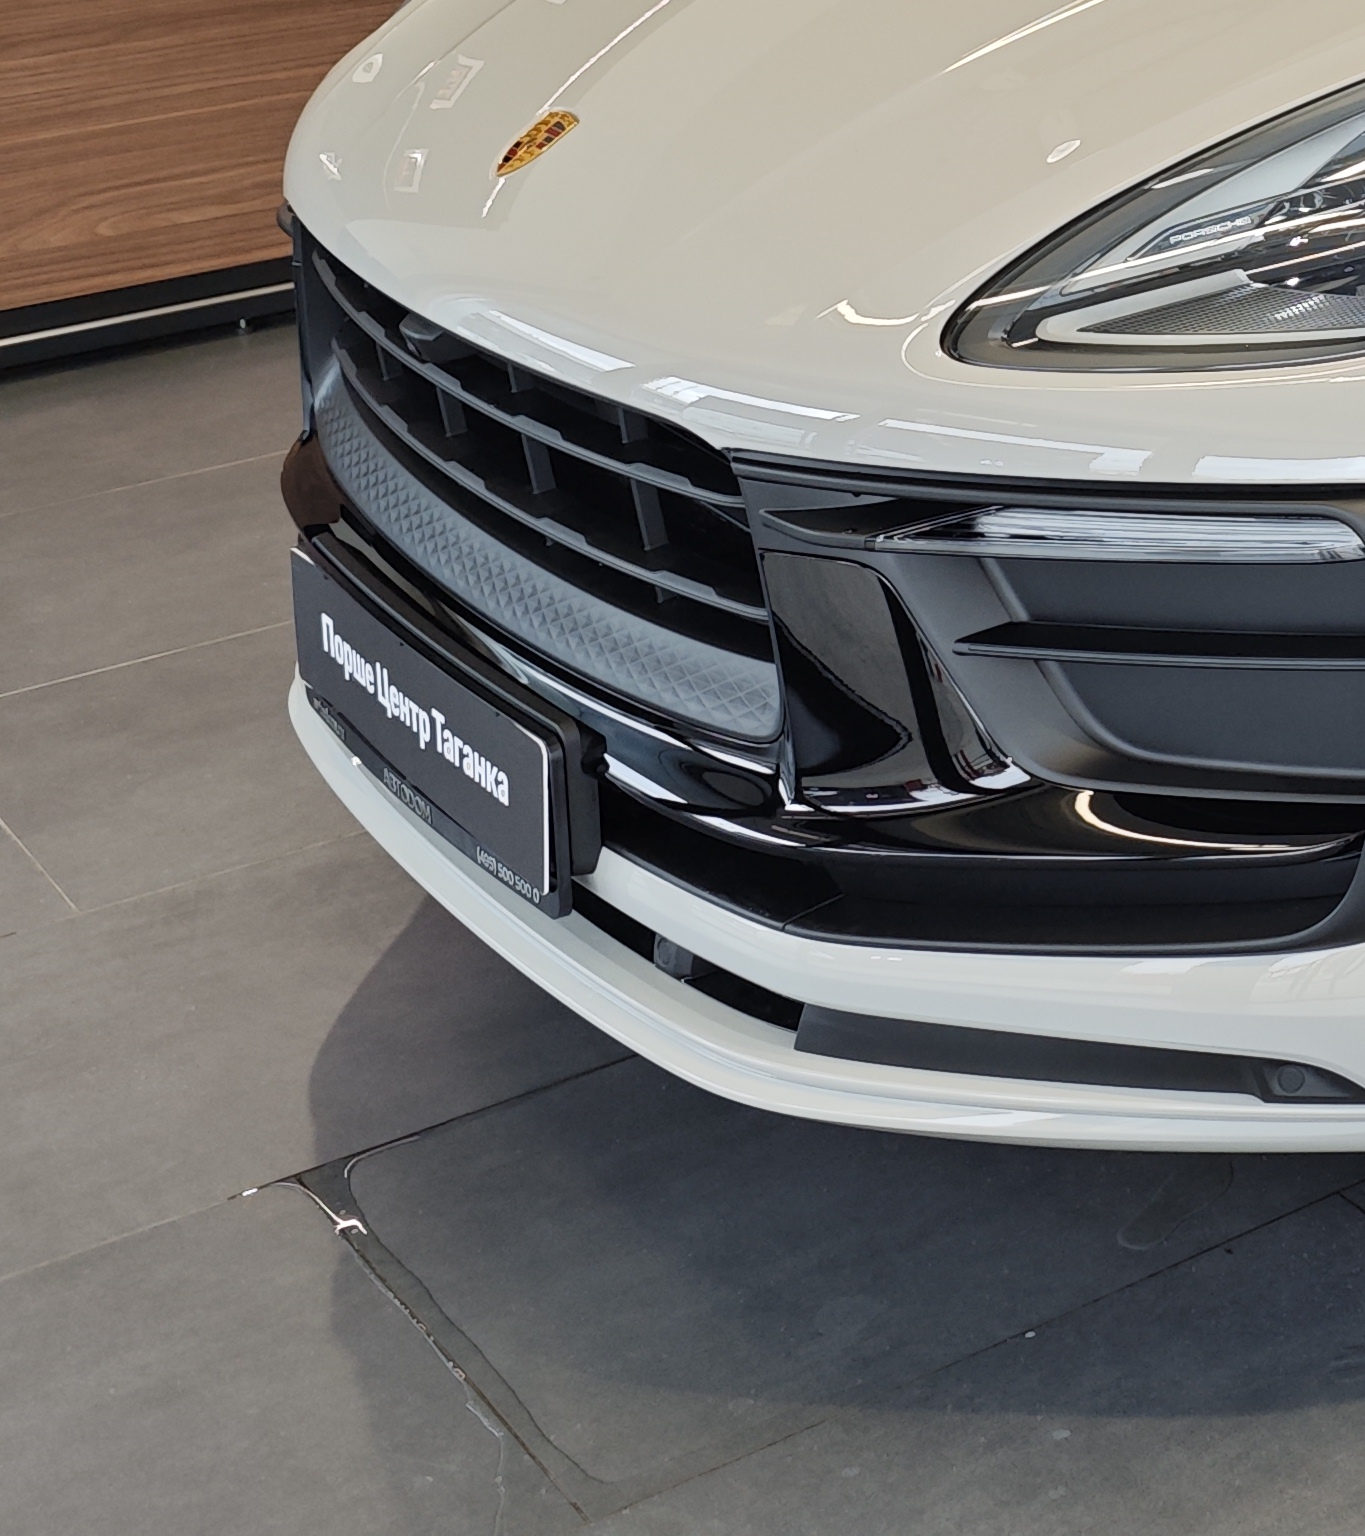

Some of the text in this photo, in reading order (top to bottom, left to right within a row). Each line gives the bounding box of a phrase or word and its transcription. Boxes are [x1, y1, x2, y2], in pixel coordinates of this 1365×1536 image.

[320, 611, 375, 695] Порше
[375, 661, 431, 750] Центр
[431, 707, 510, 807] Таганка
[497, 862, 515, 886] 500
[514, 875, 532, 899] 500
